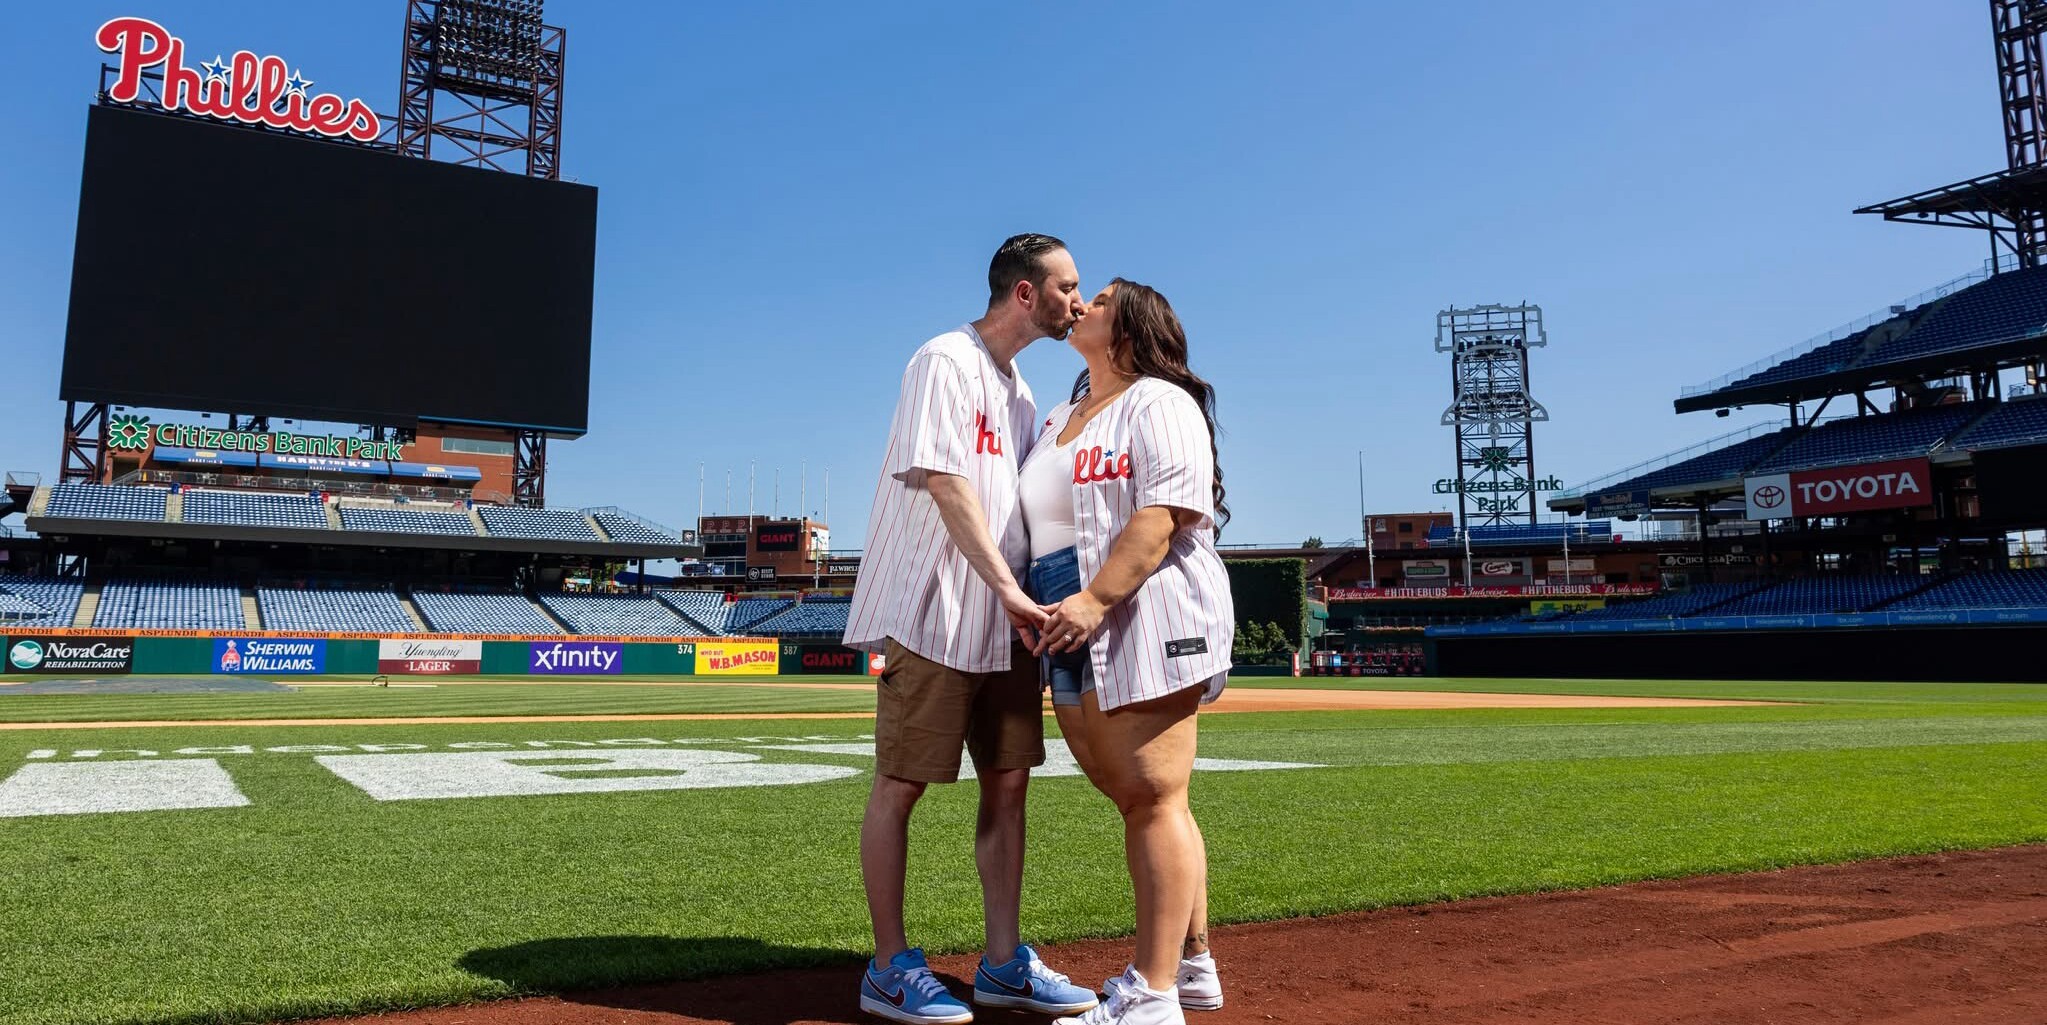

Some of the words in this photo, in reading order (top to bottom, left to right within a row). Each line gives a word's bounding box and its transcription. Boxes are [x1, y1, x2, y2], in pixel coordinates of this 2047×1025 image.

[95, 17, 380, 141] Phillies
[156, 424, 269, 451] Citizens
[275, 431, 342, 457] Bank
[346, 437, 403, 461] Park
[277, 456, 326, 465] HARRY
[1435, 478, 1509, 493] Citizens
[1513, 475, 1561, 491] Bank
[1797, 472, 1920, 504] TOYOTA
[1478, 495, 1517, 512] Park
[759, 533, 796, 543] GIANT
[44, 642, 131, 659] NovaCare
[245, 641, 315, 656] SHERWIN
[399, 642, 463, 659] Yuengling
[535, 643, 618, 670] xfinity
[678, 645, 693, 655] 374
[783, 646, 798, 656] 387
[44, 661, 127, 669] REHABILITATION
[409, 661, 451, 671] LAGER
[710, 651, 776, 670] W.B.MASON
[802, 653, 856, 667] GIANT
